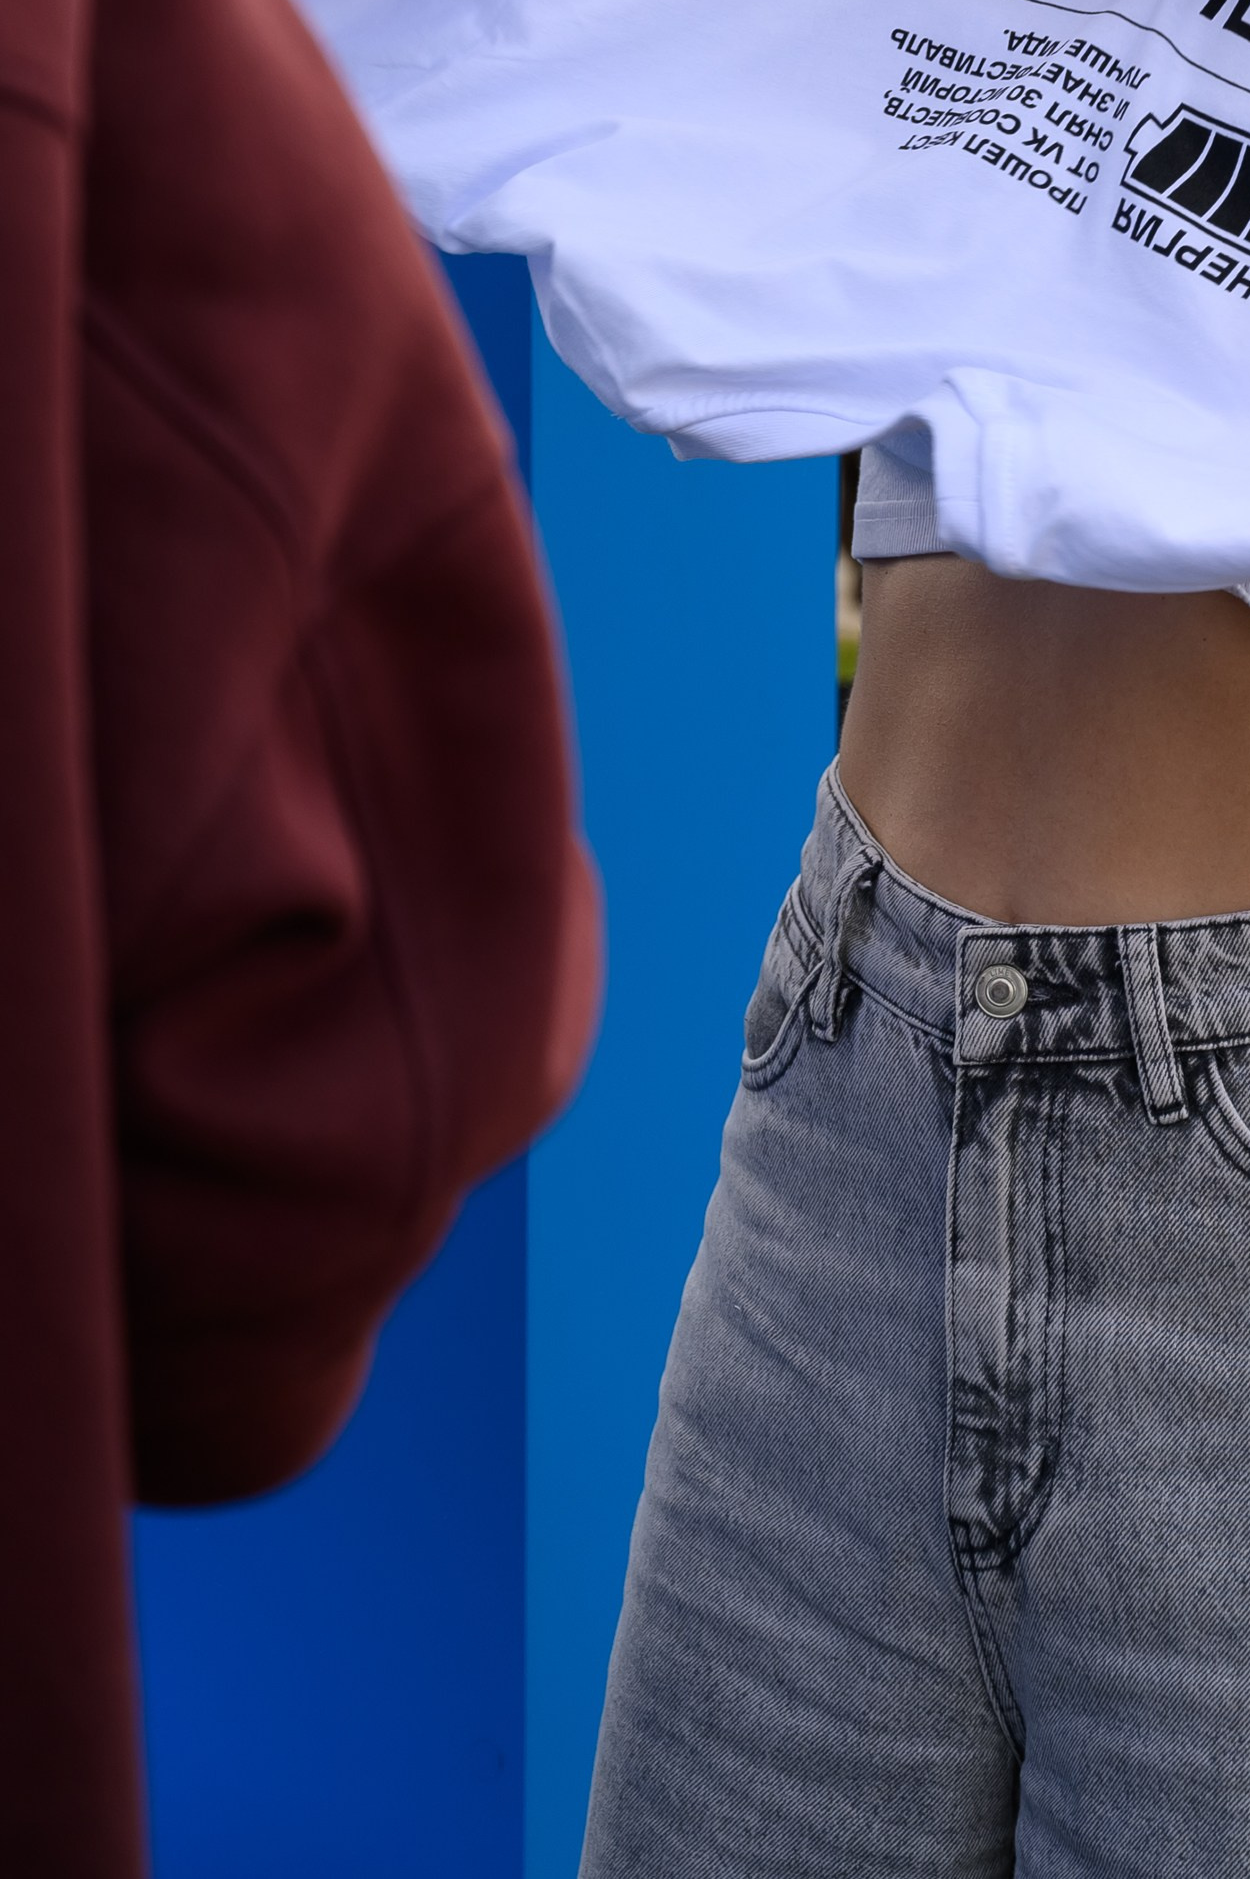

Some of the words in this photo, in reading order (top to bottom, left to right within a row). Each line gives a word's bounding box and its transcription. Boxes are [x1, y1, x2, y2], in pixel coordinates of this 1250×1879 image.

[890, 28, 1034, 81] ФЕСТИВАЛЬ
[1064, 38, 1151, 89] ЛУЧШЕ
[900, 67, 1009, 104] ИСТОРИЙ
[1006, 85, 1043, 109] 30
[1029, 61, 1116, 113] ЗНАЕТ
[1044, 101, 1114, 152] СНЯЛ
[1113, 98, 1131, 121] И
[1023, 127, 1065, 164] VK
[963, 134, 1088, 215] ПРОШЕЛ
[1067, 156, 1100, 183] ОТ
